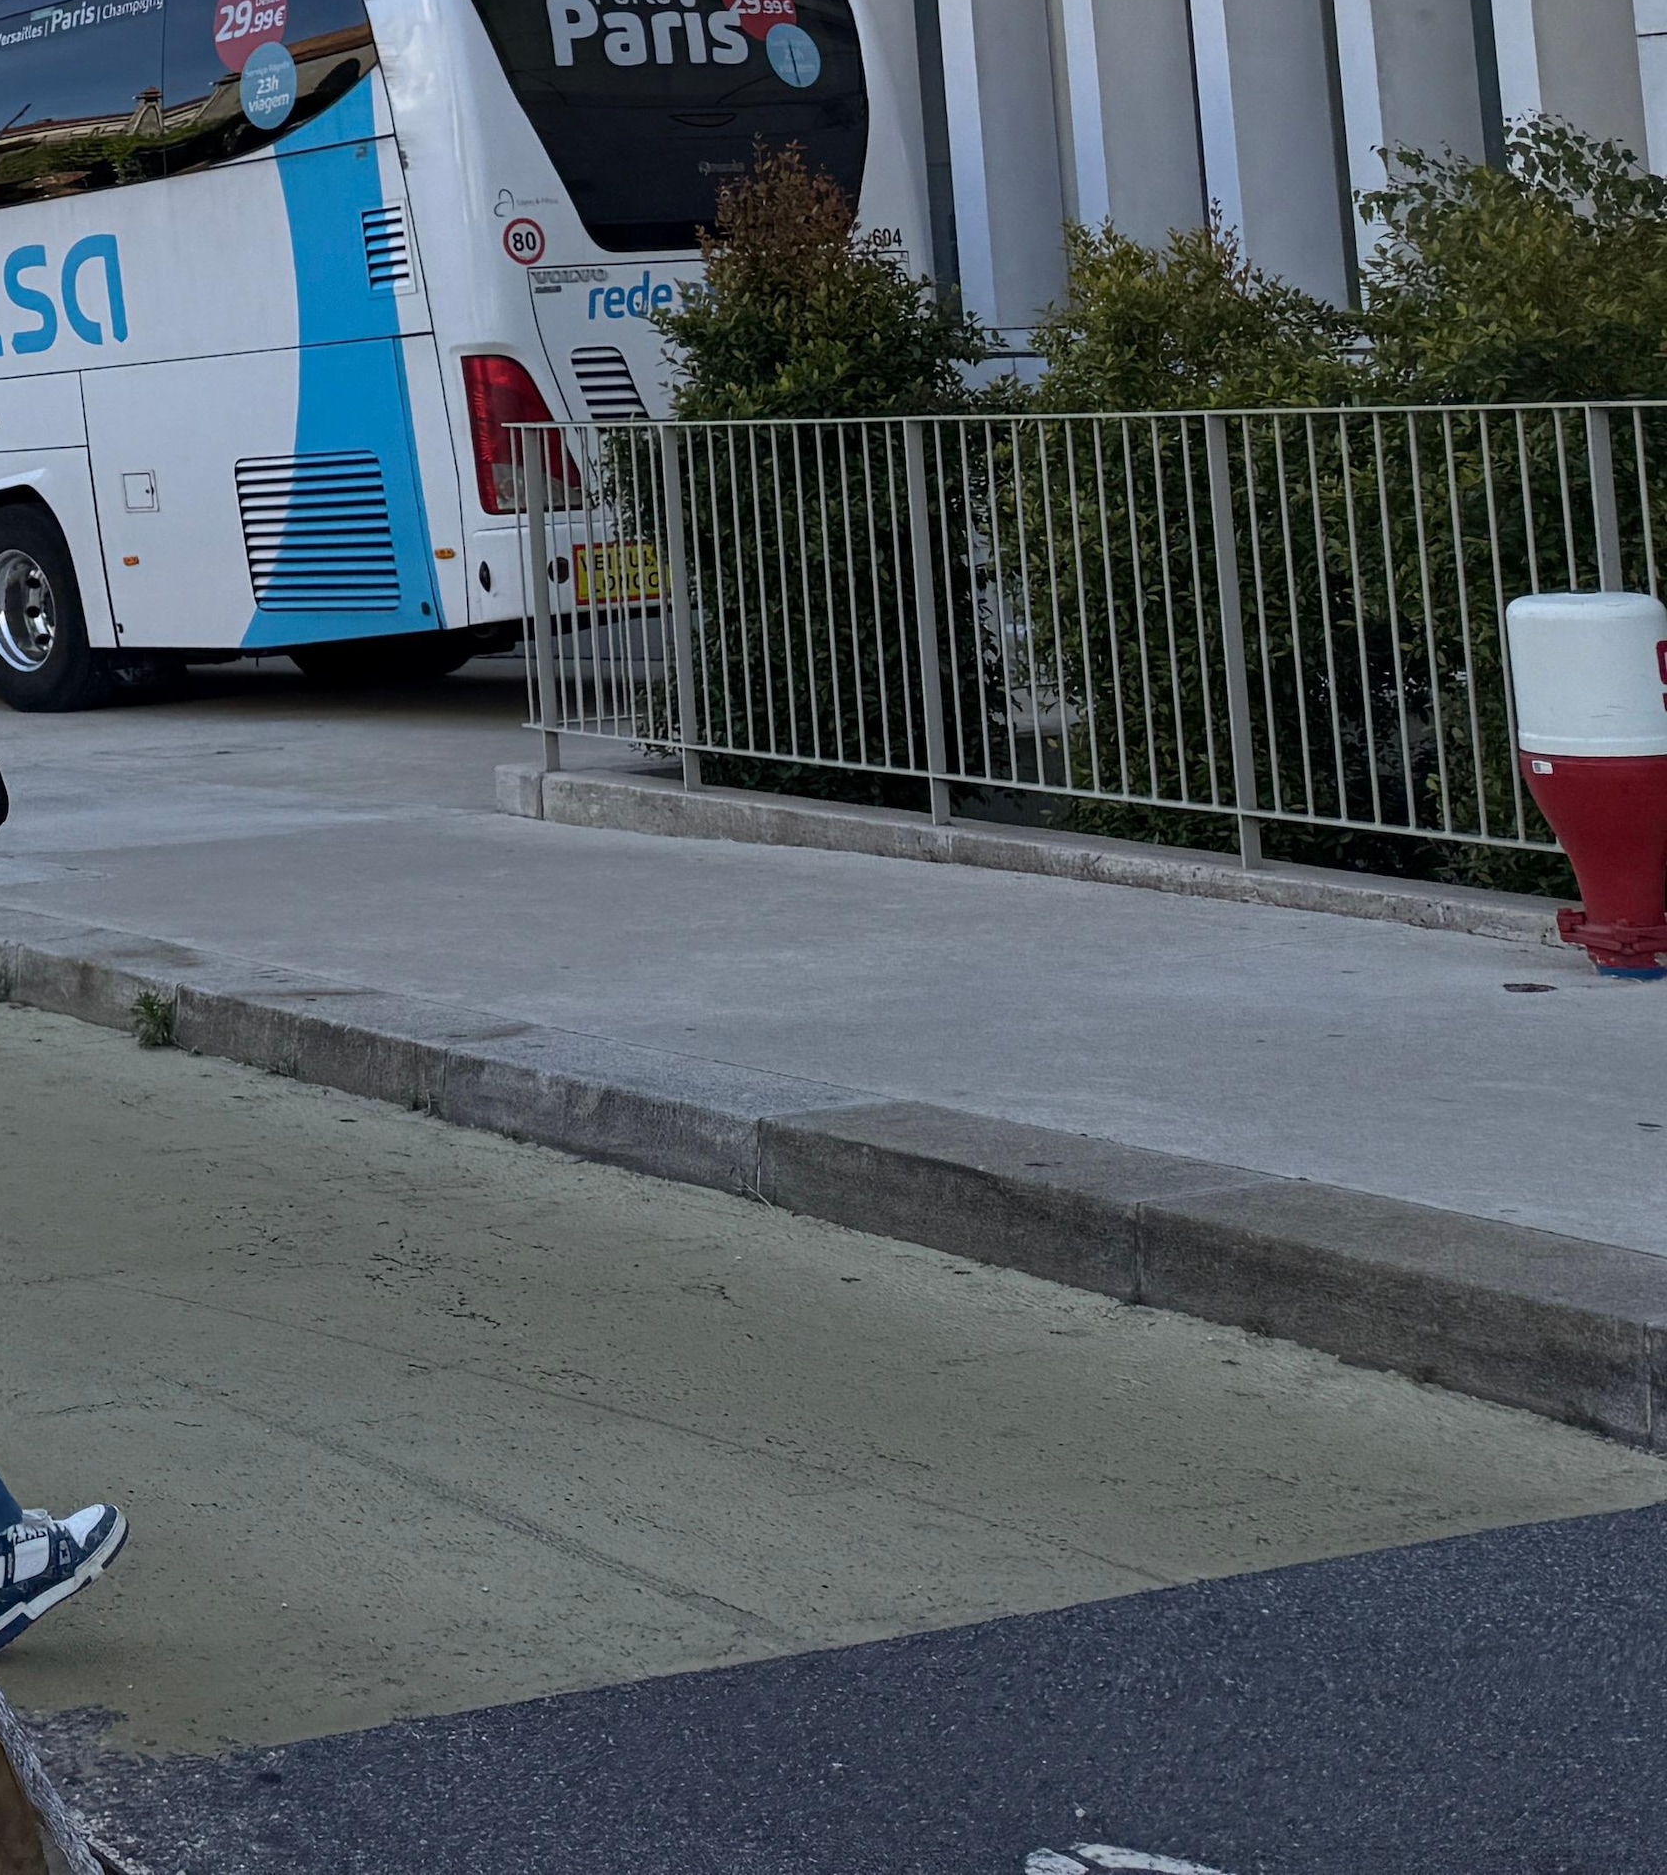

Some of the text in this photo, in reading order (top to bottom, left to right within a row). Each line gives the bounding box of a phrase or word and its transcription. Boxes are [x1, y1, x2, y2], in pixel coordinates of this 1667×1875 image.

[50, 0, 96, 34] Paris
[215, 0, 286, 43] 29.99€
[256, 74, 279, 95] 23h
[248, 92, 290, 114] viagem
[512, 231, 537, 252] 80
[530, 269, 609, 285] VOLVO
[588, 270, 673, 320] rede
